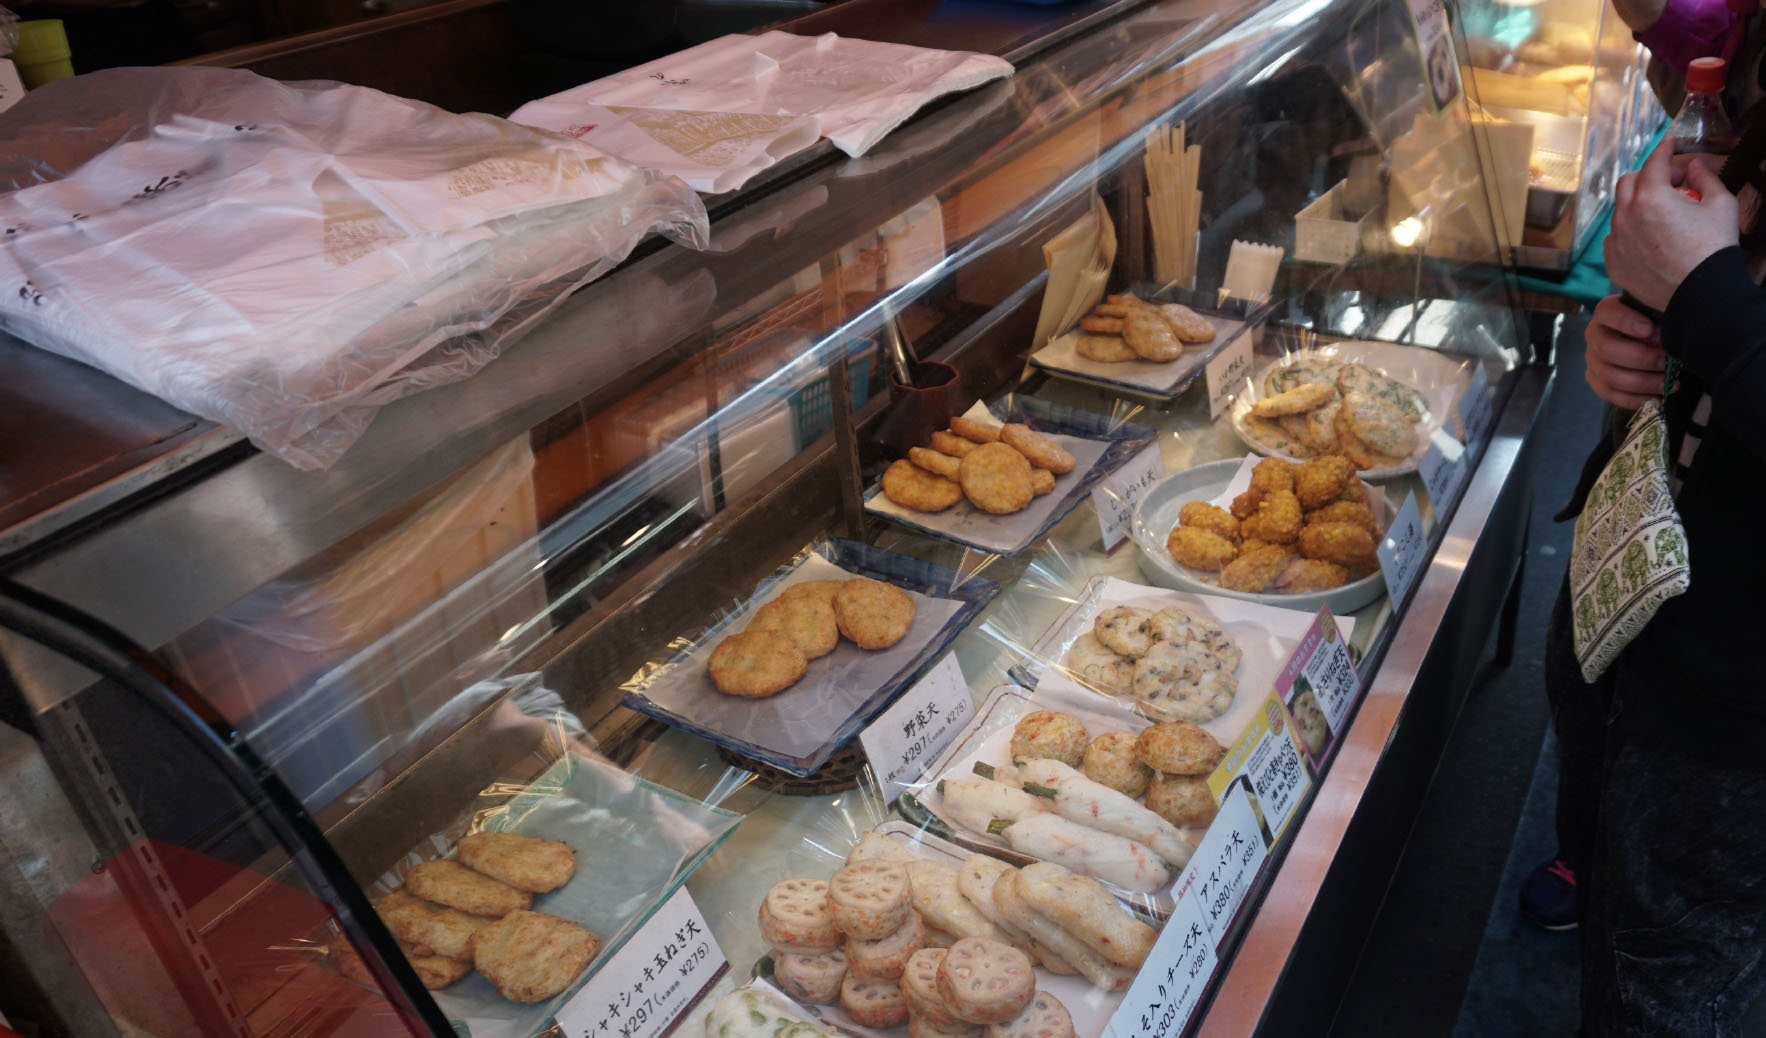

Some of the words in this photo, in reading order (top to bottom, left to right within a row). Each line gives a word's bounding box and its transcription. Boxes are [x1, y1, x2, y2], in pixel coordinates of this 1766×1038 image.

[903, 701, 940, 739] 野菜天
[1283, 752, 1298, 780] ¥380
[1200, 830, 1243, 903] アスパラ天
[679, 942, 709, 976] ¥275)
[1131, 922, 1202, 1038] そ入りチーズ天
